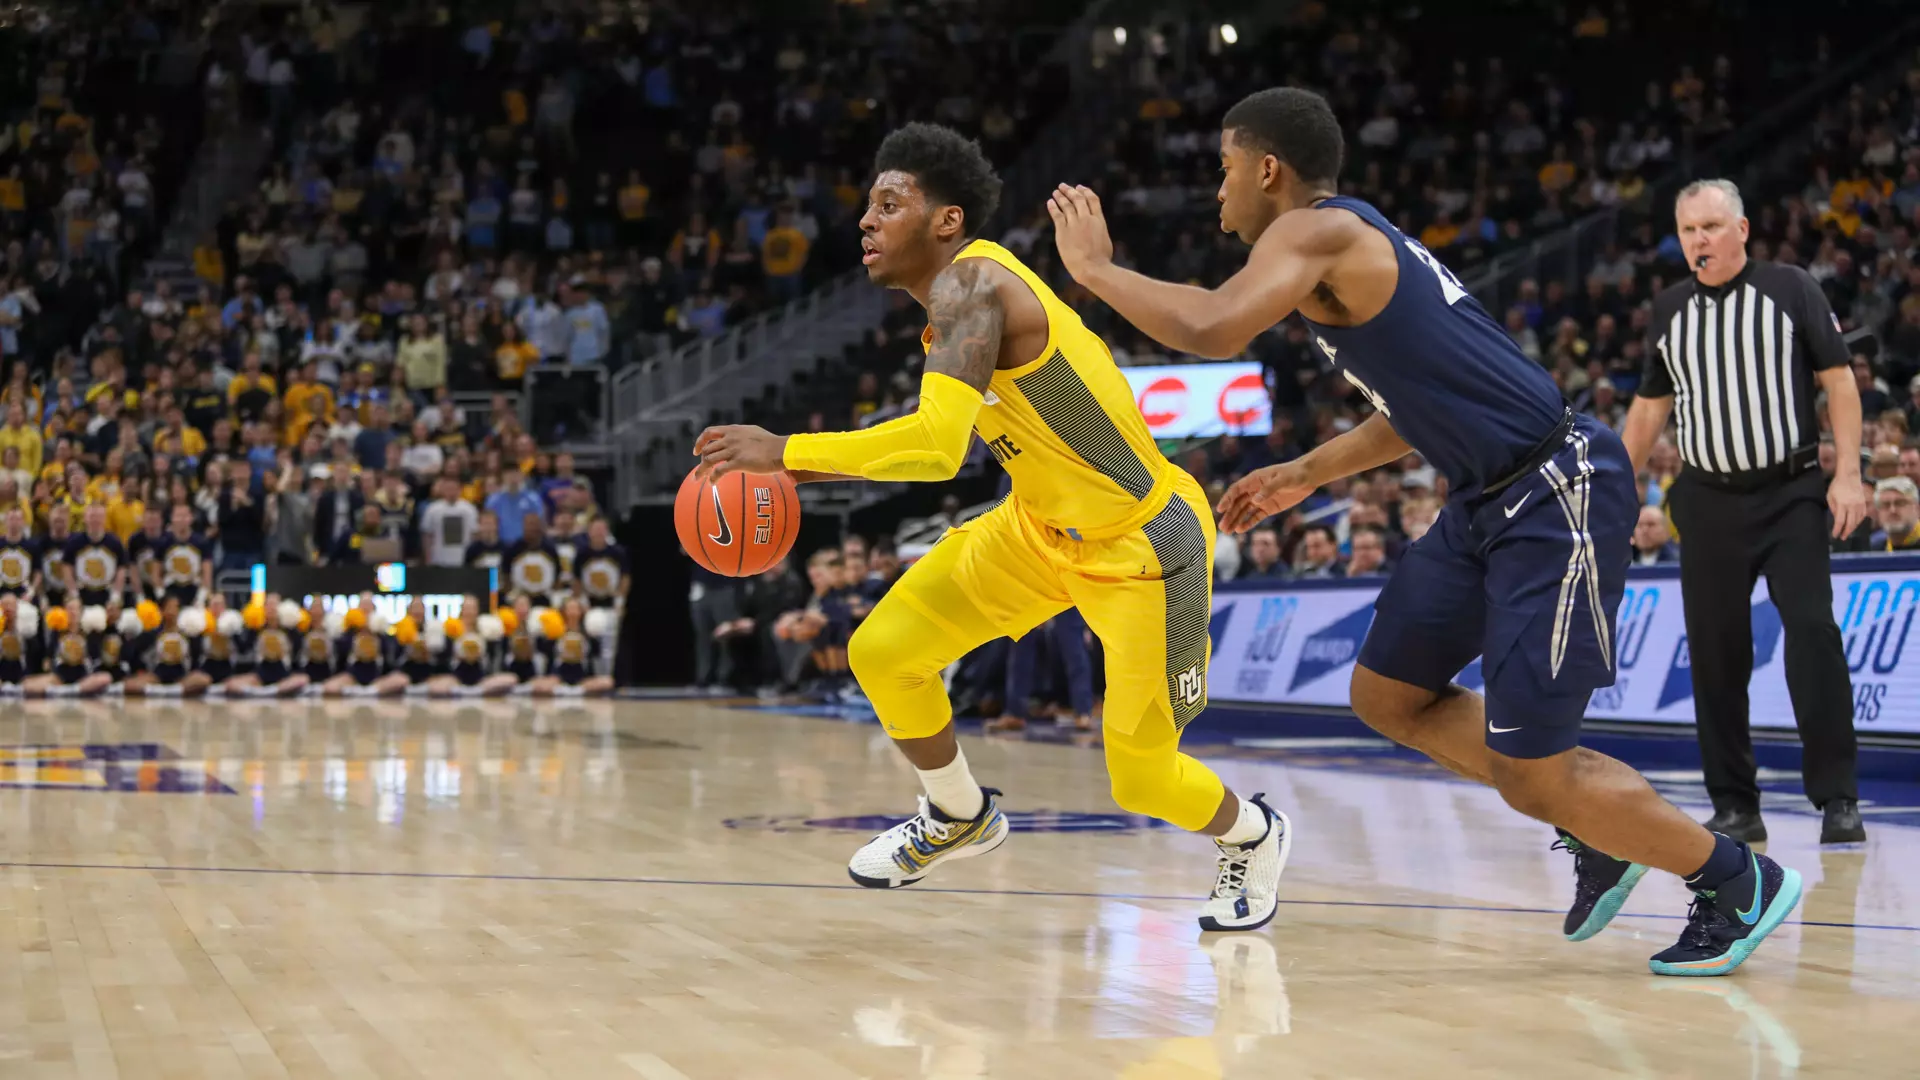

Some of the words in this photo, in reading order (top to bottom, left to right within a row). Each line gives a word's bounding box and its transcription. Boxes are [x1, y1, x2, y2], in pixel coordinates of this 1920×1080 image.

[754, 488, 770, 544] ELITE
[1838, 578, 1920, 675] 100
[1175, 660, 1203, 707] MU
